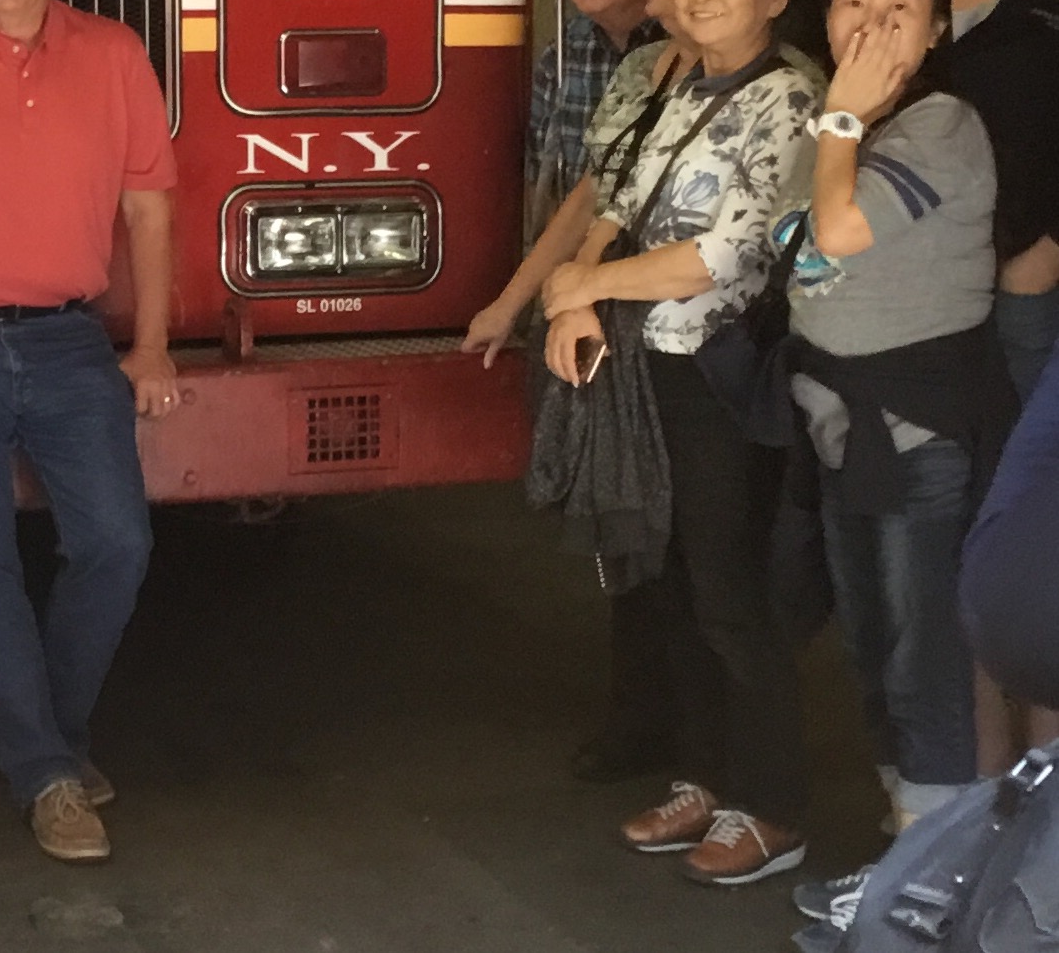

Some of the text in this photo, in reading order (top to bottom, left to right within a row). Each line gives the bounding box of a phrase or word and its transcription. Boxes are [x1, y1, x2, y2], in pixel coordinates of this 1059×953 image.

[236, 131, 430, 174] N.Y.
[296, 298, 362, 313] SL 01026
